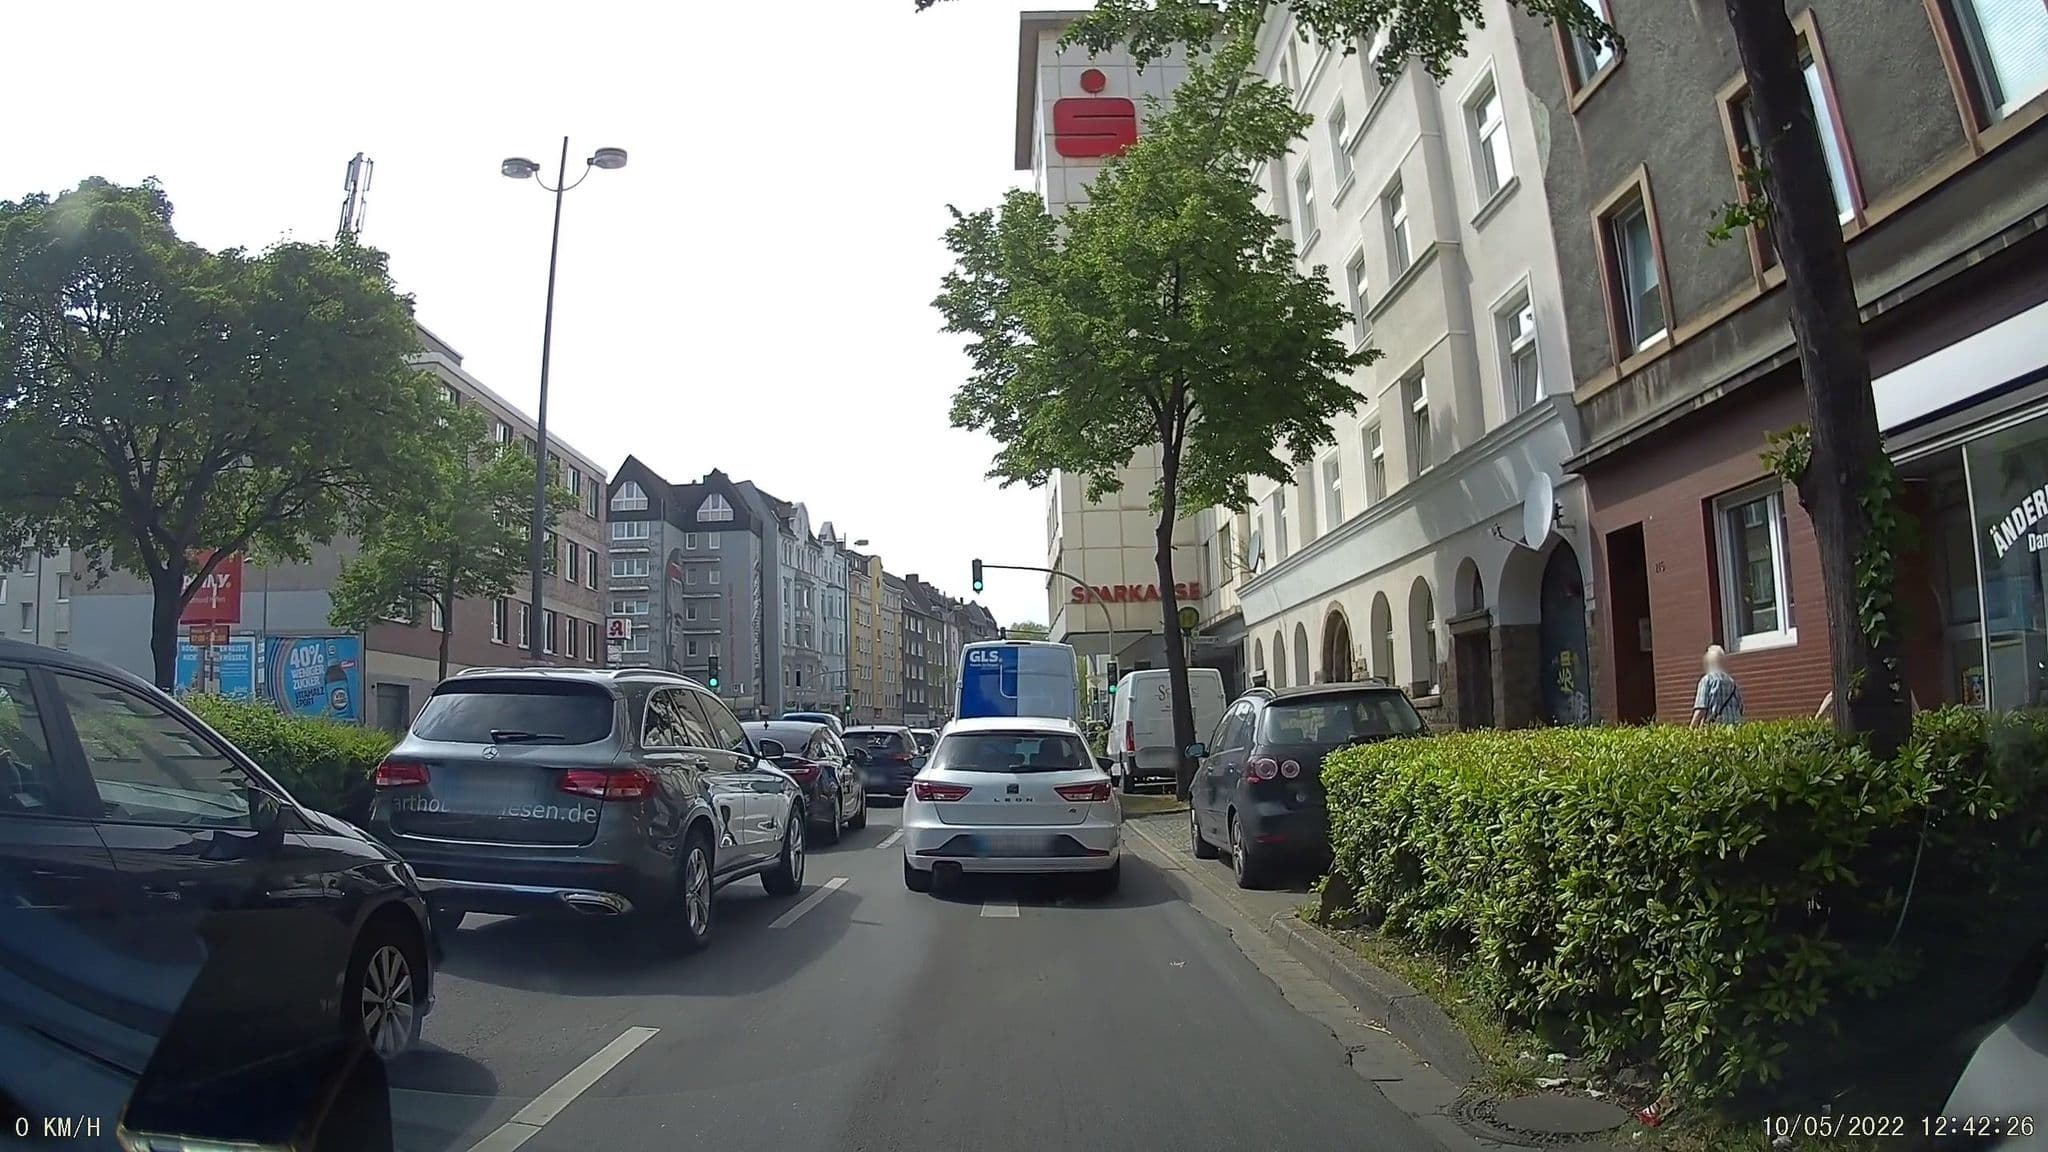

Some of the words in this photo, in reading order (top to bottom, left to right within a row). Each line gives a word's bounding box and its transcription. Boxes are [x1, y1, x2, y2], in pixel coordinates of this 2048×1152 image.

[1071, 581, 1201, 604] SPARKASE
[290, 643, 324, 668] 40%
[291, 665, 325, 679] WENIGER
[293, 676, 321, 690] ZUCKER
